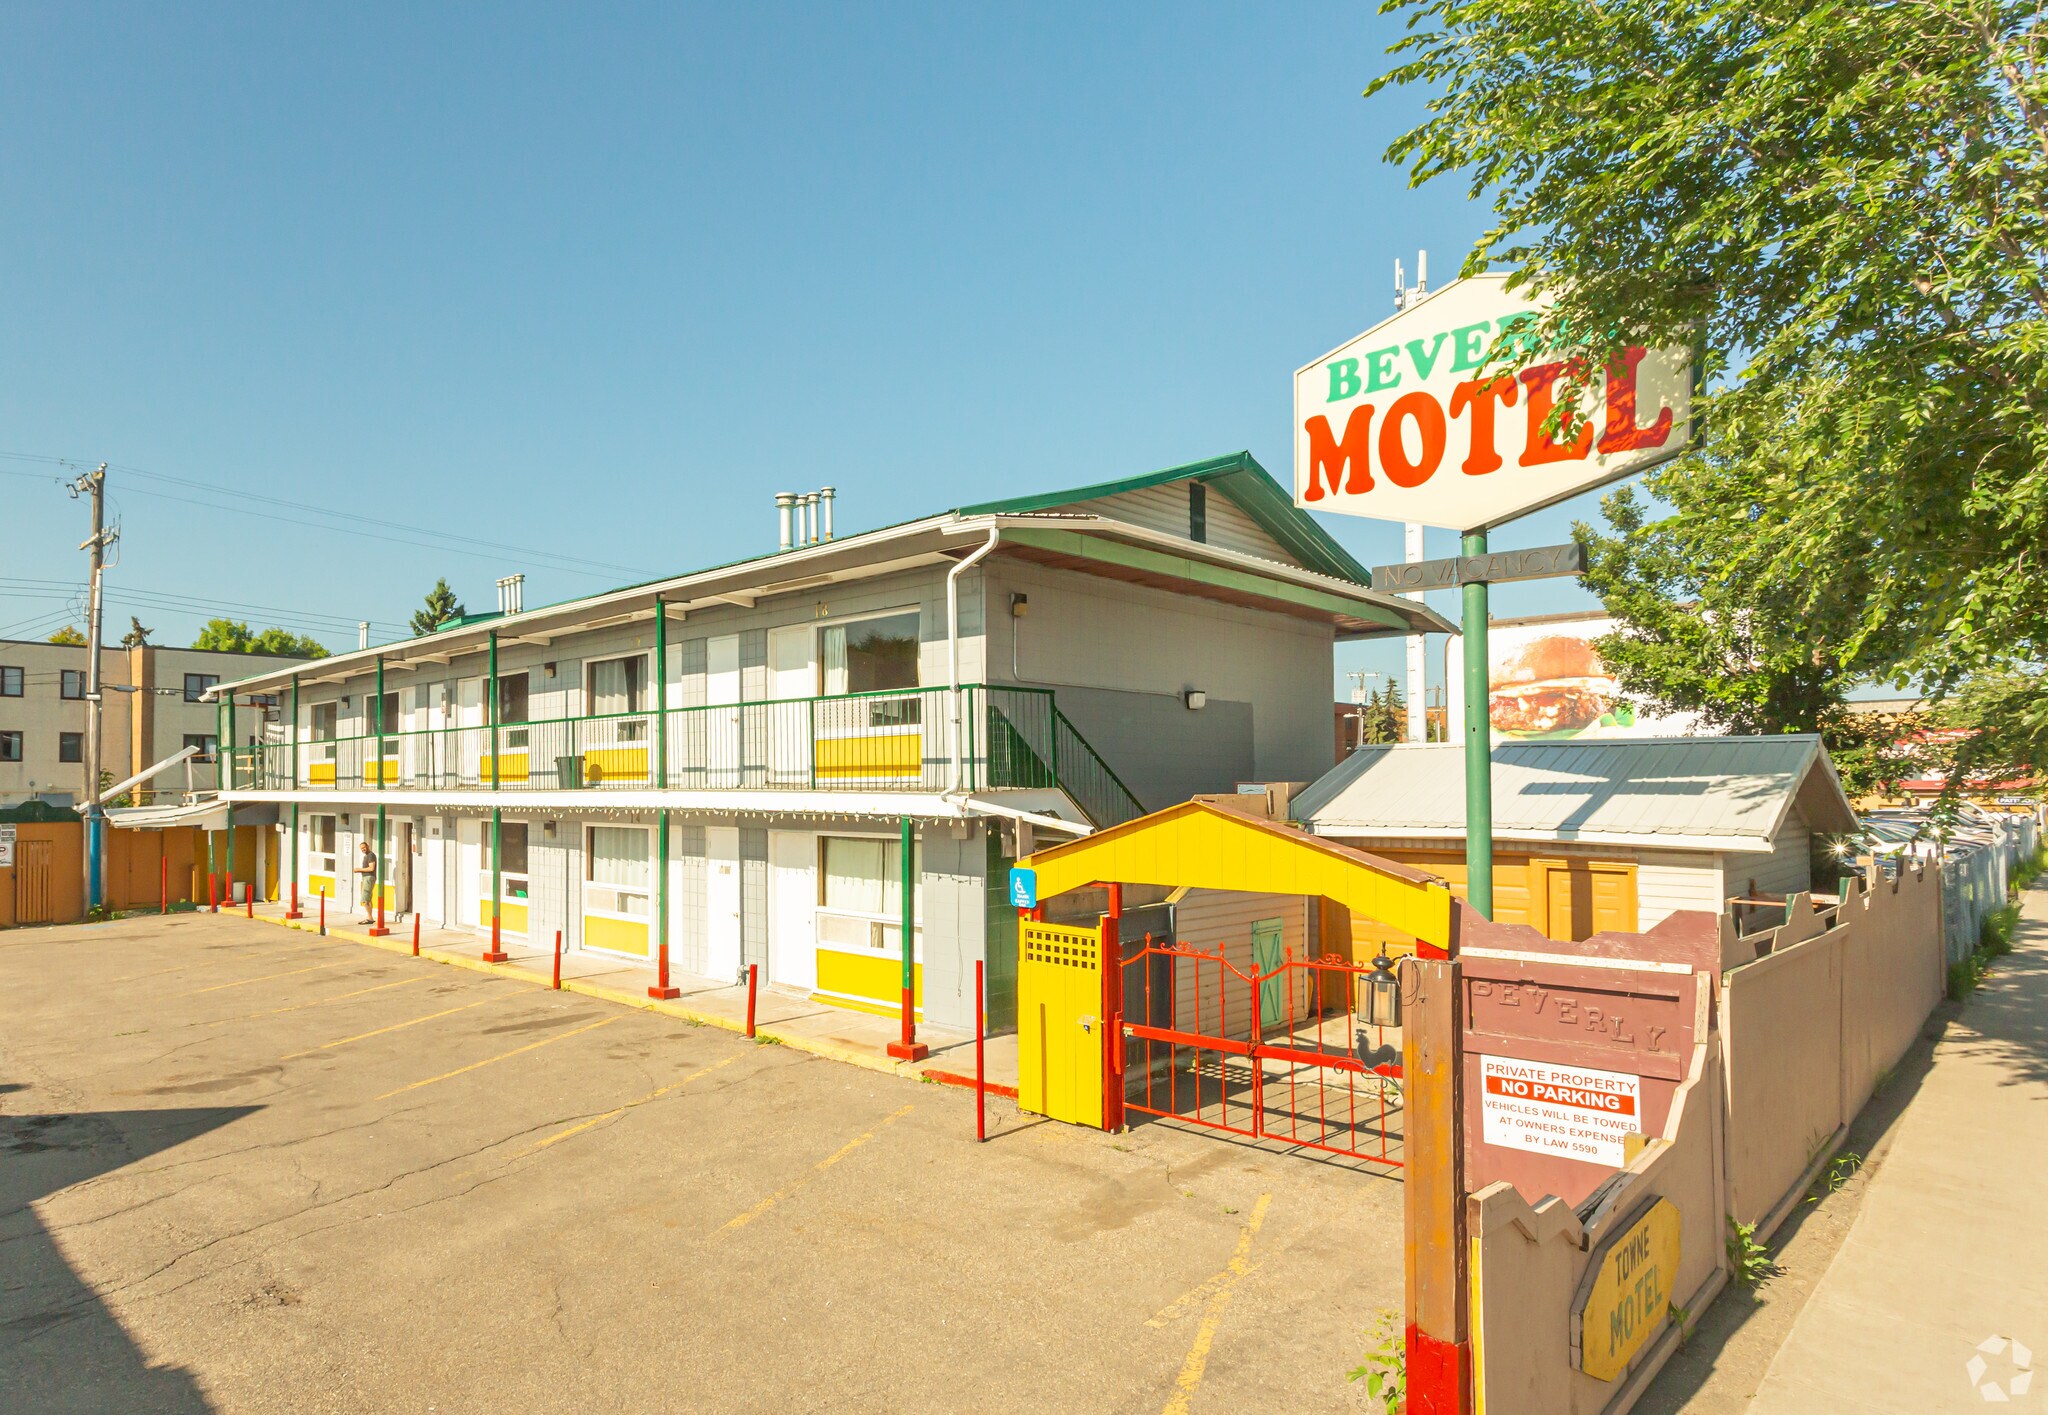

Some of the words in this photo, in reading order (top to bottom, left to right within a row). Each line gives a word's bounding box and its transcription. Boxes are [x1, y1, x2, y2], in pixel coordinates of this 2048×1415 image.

[1304, 345, 1673, 502] MOTEL
[1385, 564, 1424, 586] NO
[1431, 548, 1562, 584] VACANCY
[1472, 981, 1667, 1052] BEVERLY
[1486, 1063, 1546, 1081] PRIVATE
[1551, 1072, 1636, 1094] PROPERTY
[1501, 1079, 1528, 1096] NO
[1533, 1084, 1620, 1110] PARKING
[1485, 1100, 1539, 1116] VEHICLES
[1542, 1109, 1570, 1121] WILL
[1573, 1114, 1589, 1125] BE
[1593, 1117, 1637, 1132] TOWED
[1499, 1116, 1512, 1125] AT
[1515, 1119, 1566, 1135] OWNERS
[1569, 1128, 1625, 1145] EXPENSE
[1525, 1134, 1540, 1144] BY
[1543, 1138, 1569, 1149] LAW
[1572, 1143, 1598, 1155] 5590
[1615, 1226, 1649, 1286] TOWNE
[1610, 1265, 1662, 1357] MOTEL
